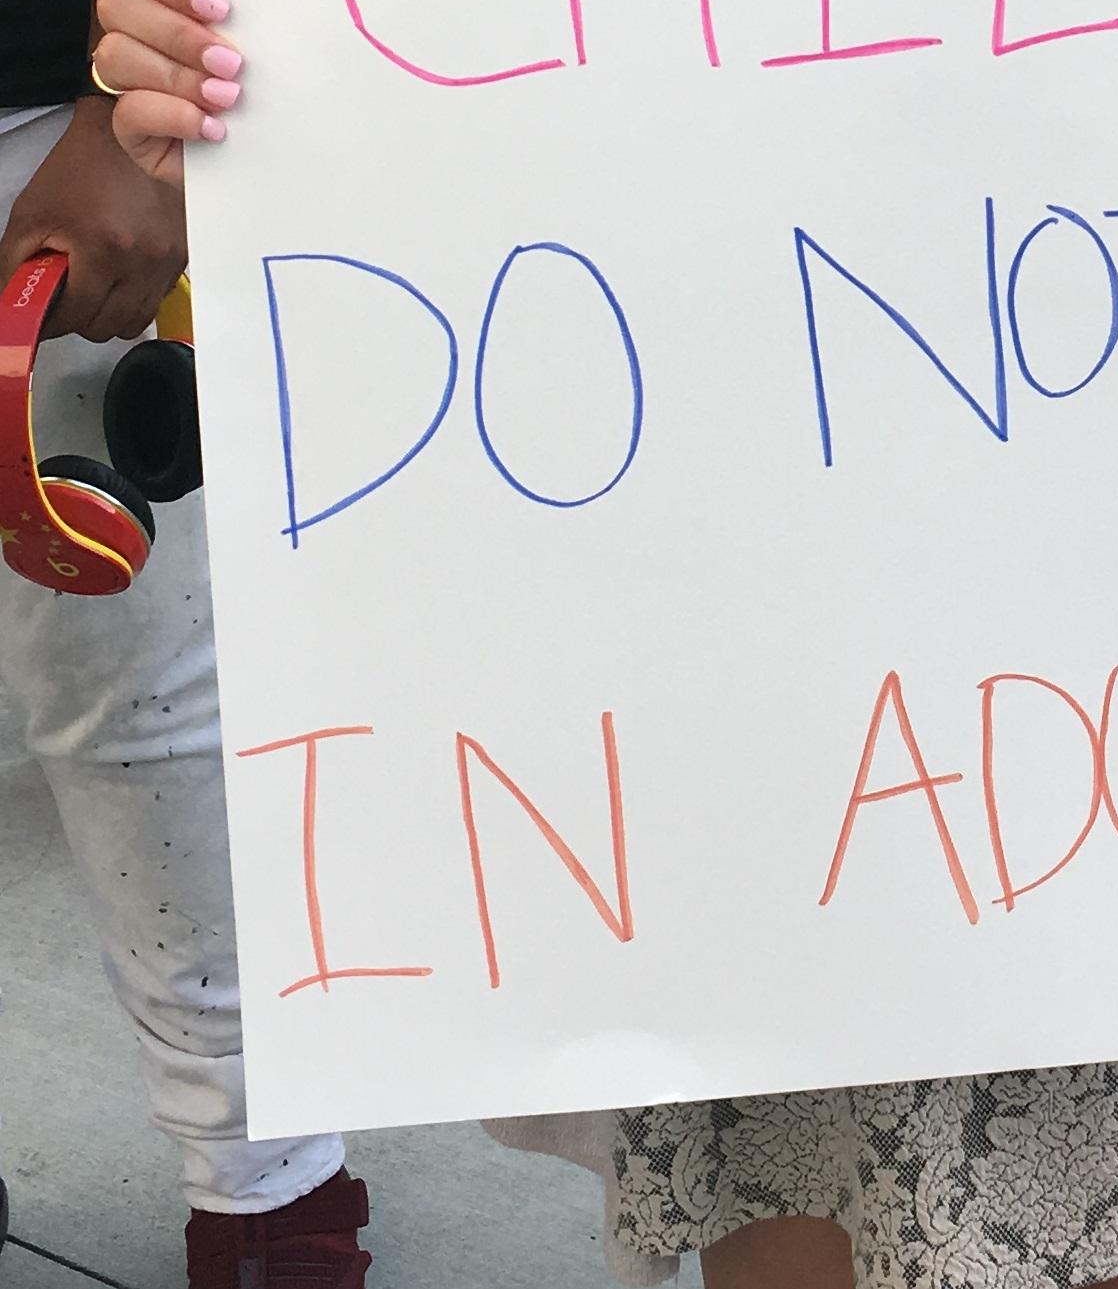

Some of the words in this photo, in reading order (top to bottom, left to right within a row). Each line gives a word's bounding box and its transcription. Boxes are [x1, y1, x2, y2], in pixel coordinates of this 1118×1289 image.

[13, 267, 46, 307] beats
[263, 243, 643, 550] DO
[239, 712, 634, 996] IN
